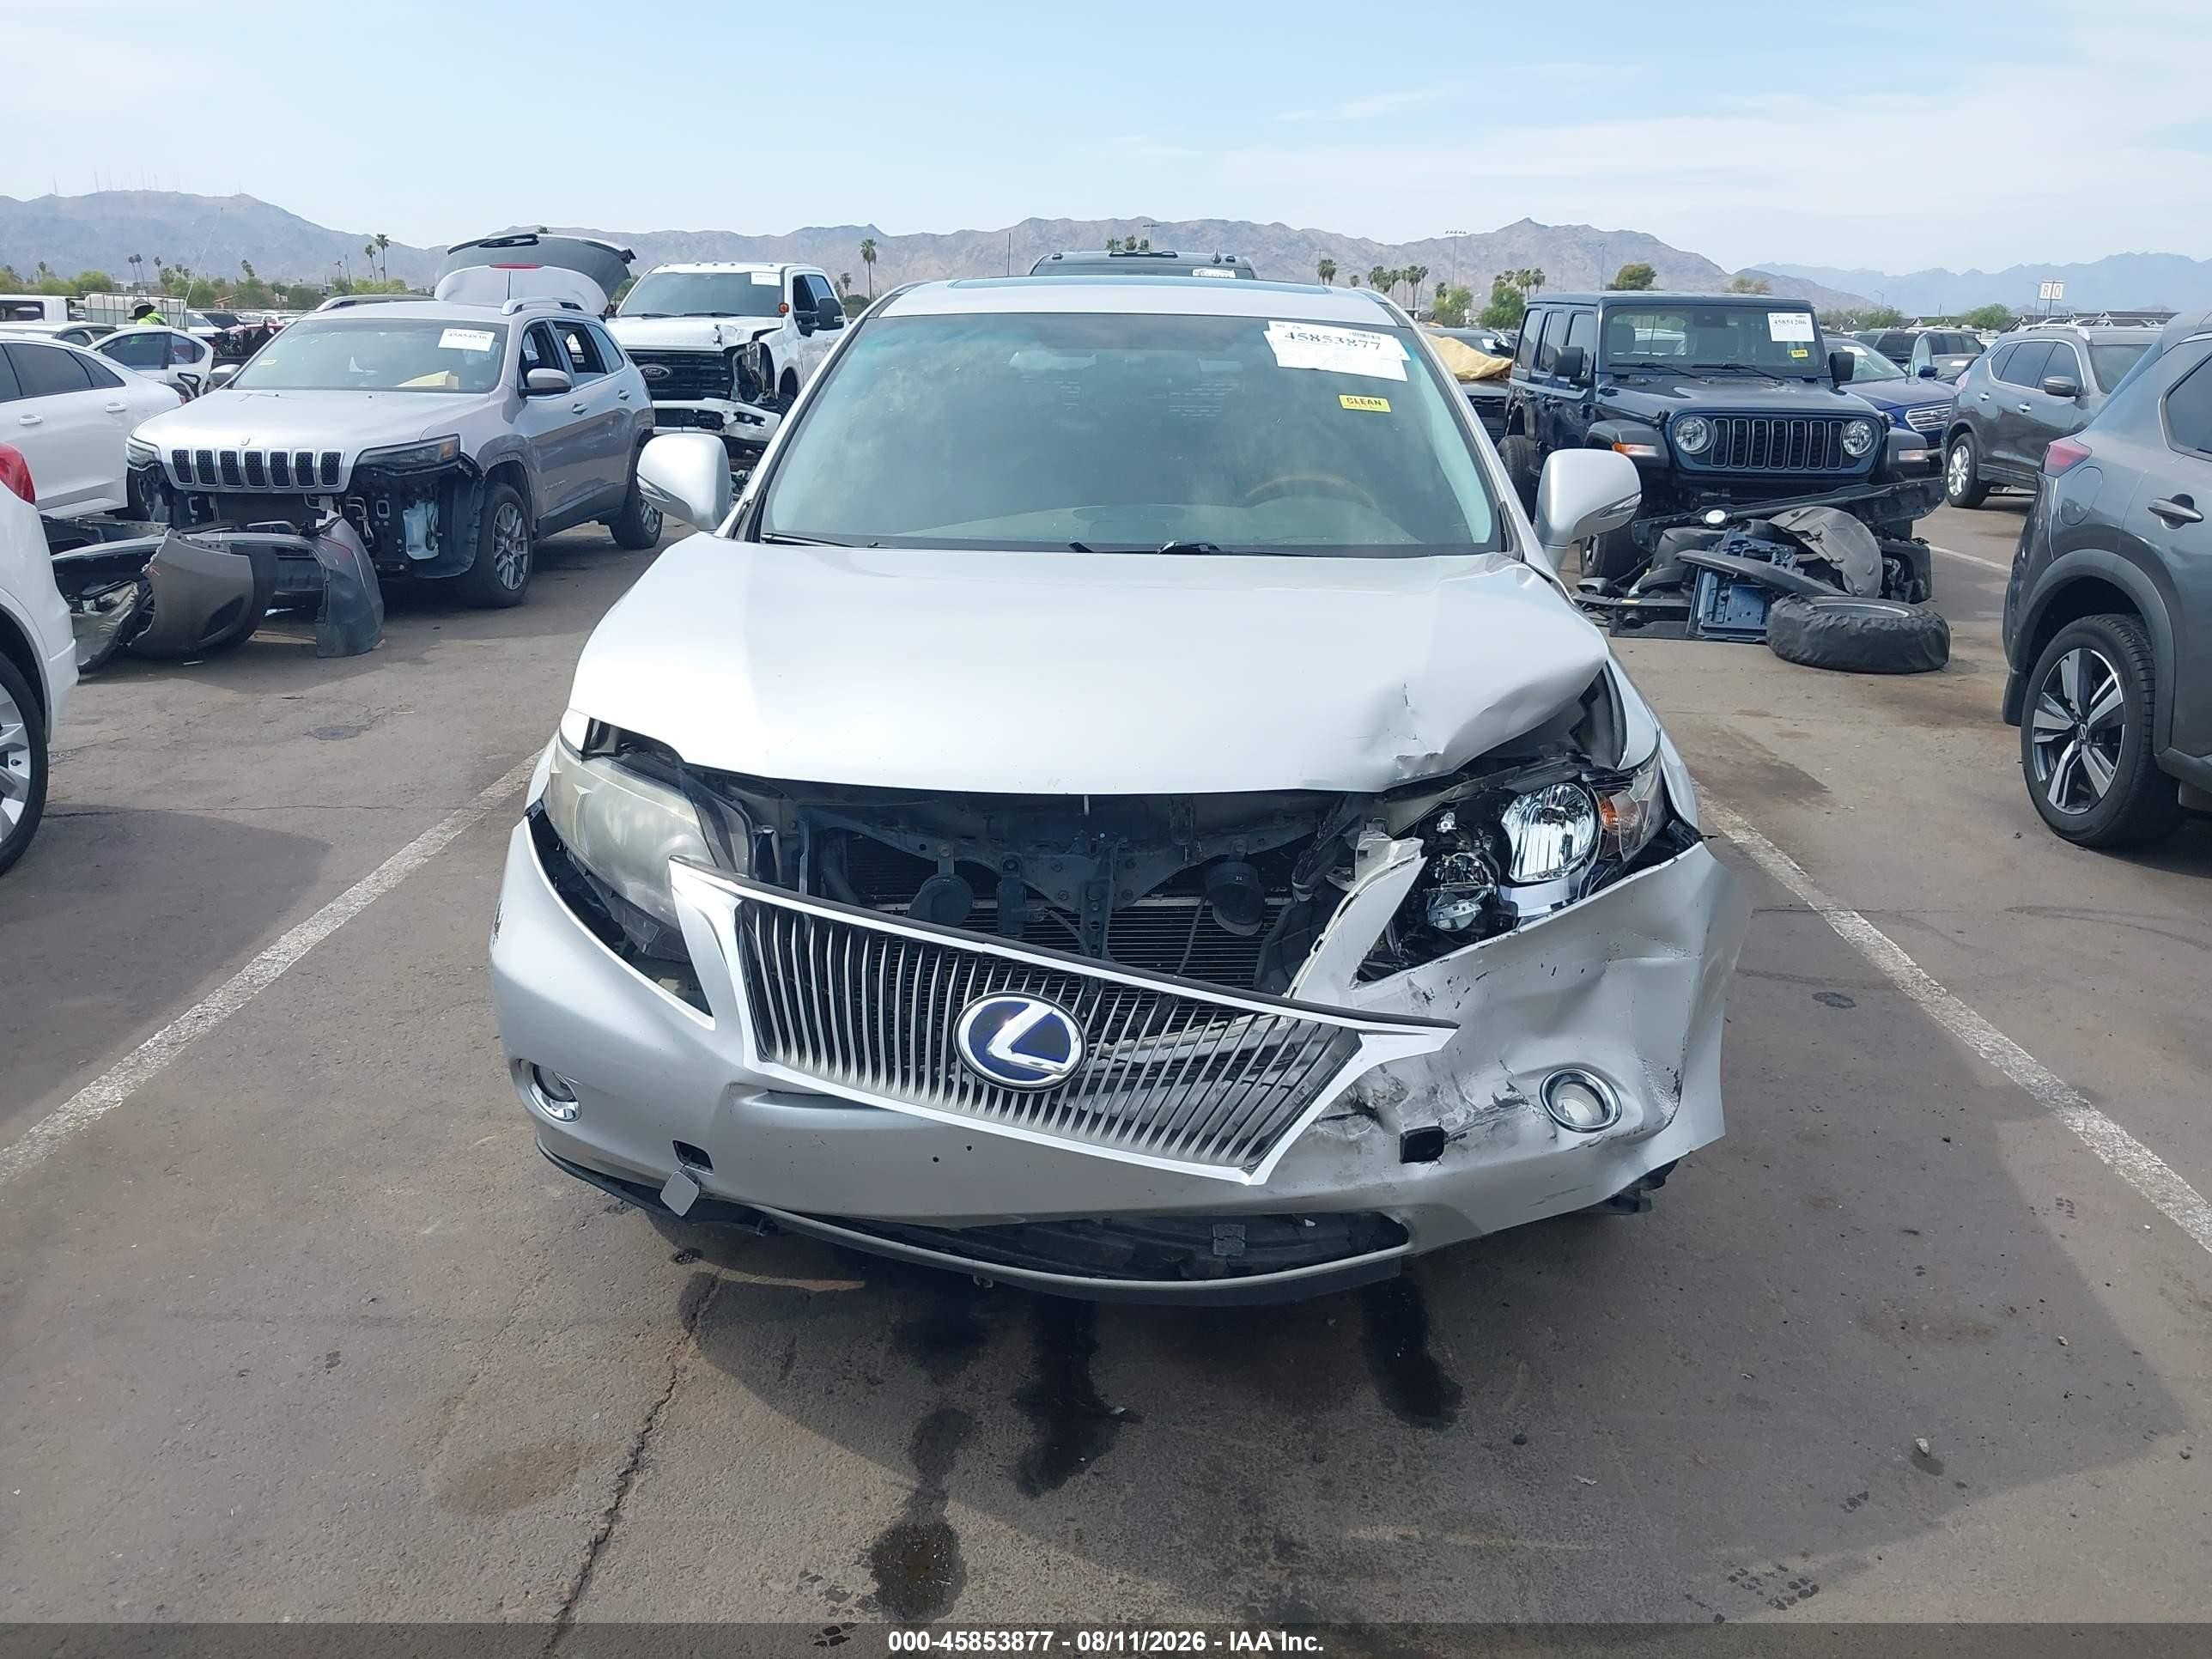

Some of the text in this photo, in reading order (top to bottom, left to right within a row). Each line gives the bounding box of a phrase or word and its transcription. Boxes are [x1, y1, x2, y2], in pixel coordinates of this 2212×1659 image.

[1285, 331, 1381, 350] 45853877
[645, 368, 663, 377] Ford
[1346, 397, 1382, 407] CLEAN
